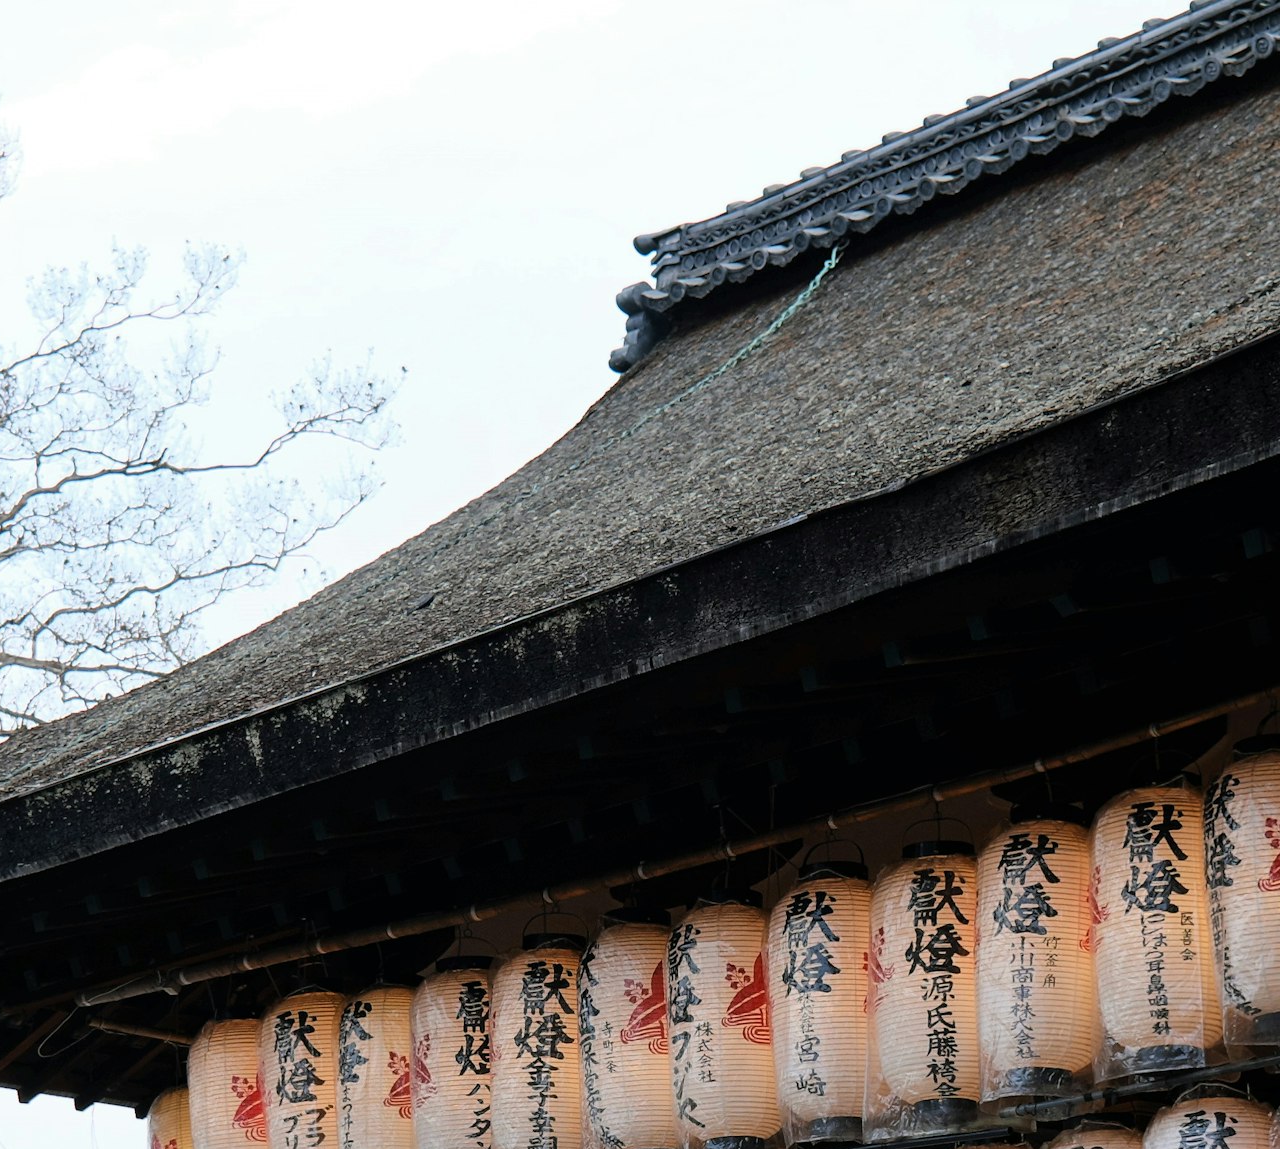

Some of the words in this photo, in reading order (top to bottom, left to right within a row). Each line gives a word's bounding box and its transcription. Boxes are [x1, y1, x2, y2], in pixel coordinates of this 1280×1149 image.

[1180, 912, 1196, 961] 医善会
[602, 1021, 618, 1073] 寺町二条
[694, 1021, 716, 1083] 株式会社
[921, 974, 961, 1099] 源氏藤袴会
